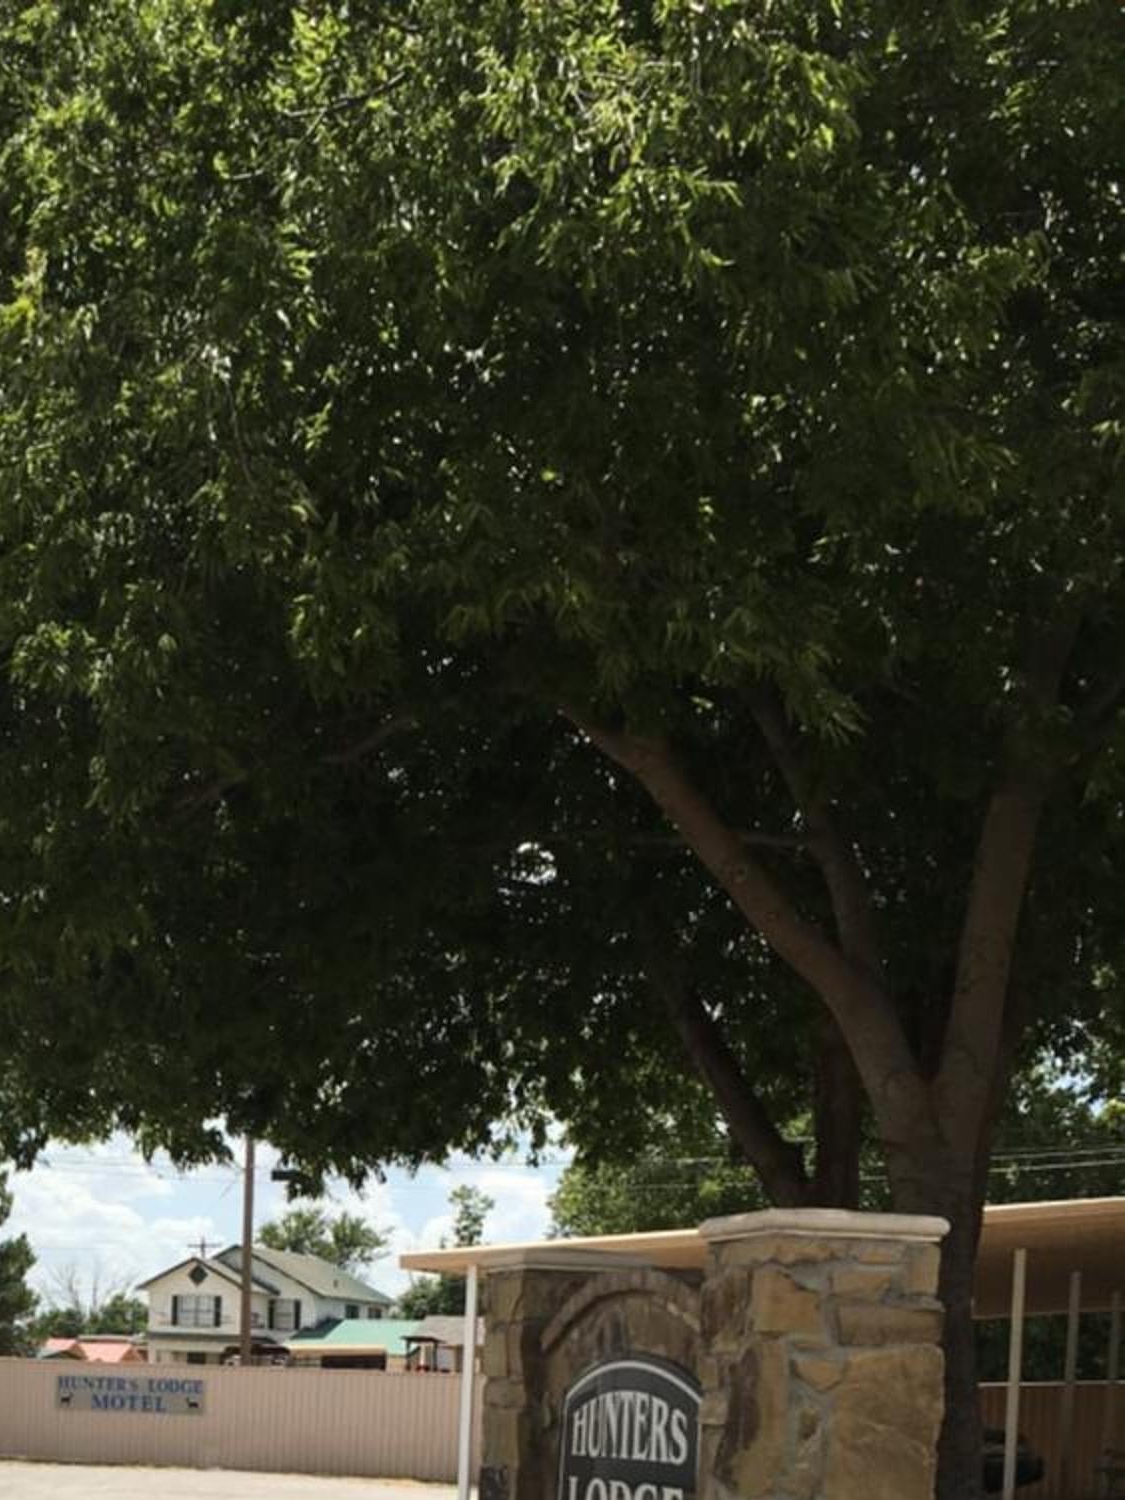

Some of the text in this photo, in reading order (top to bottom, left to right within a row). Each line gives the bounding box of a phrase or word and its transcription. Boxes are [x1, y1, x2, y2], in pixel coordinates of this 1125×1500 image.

[148, 1379, 203, 1393] LODGE
[92, 1394, 167, 1412] MOTEL
[571, 1391, 687, 1465] HUNTERS
